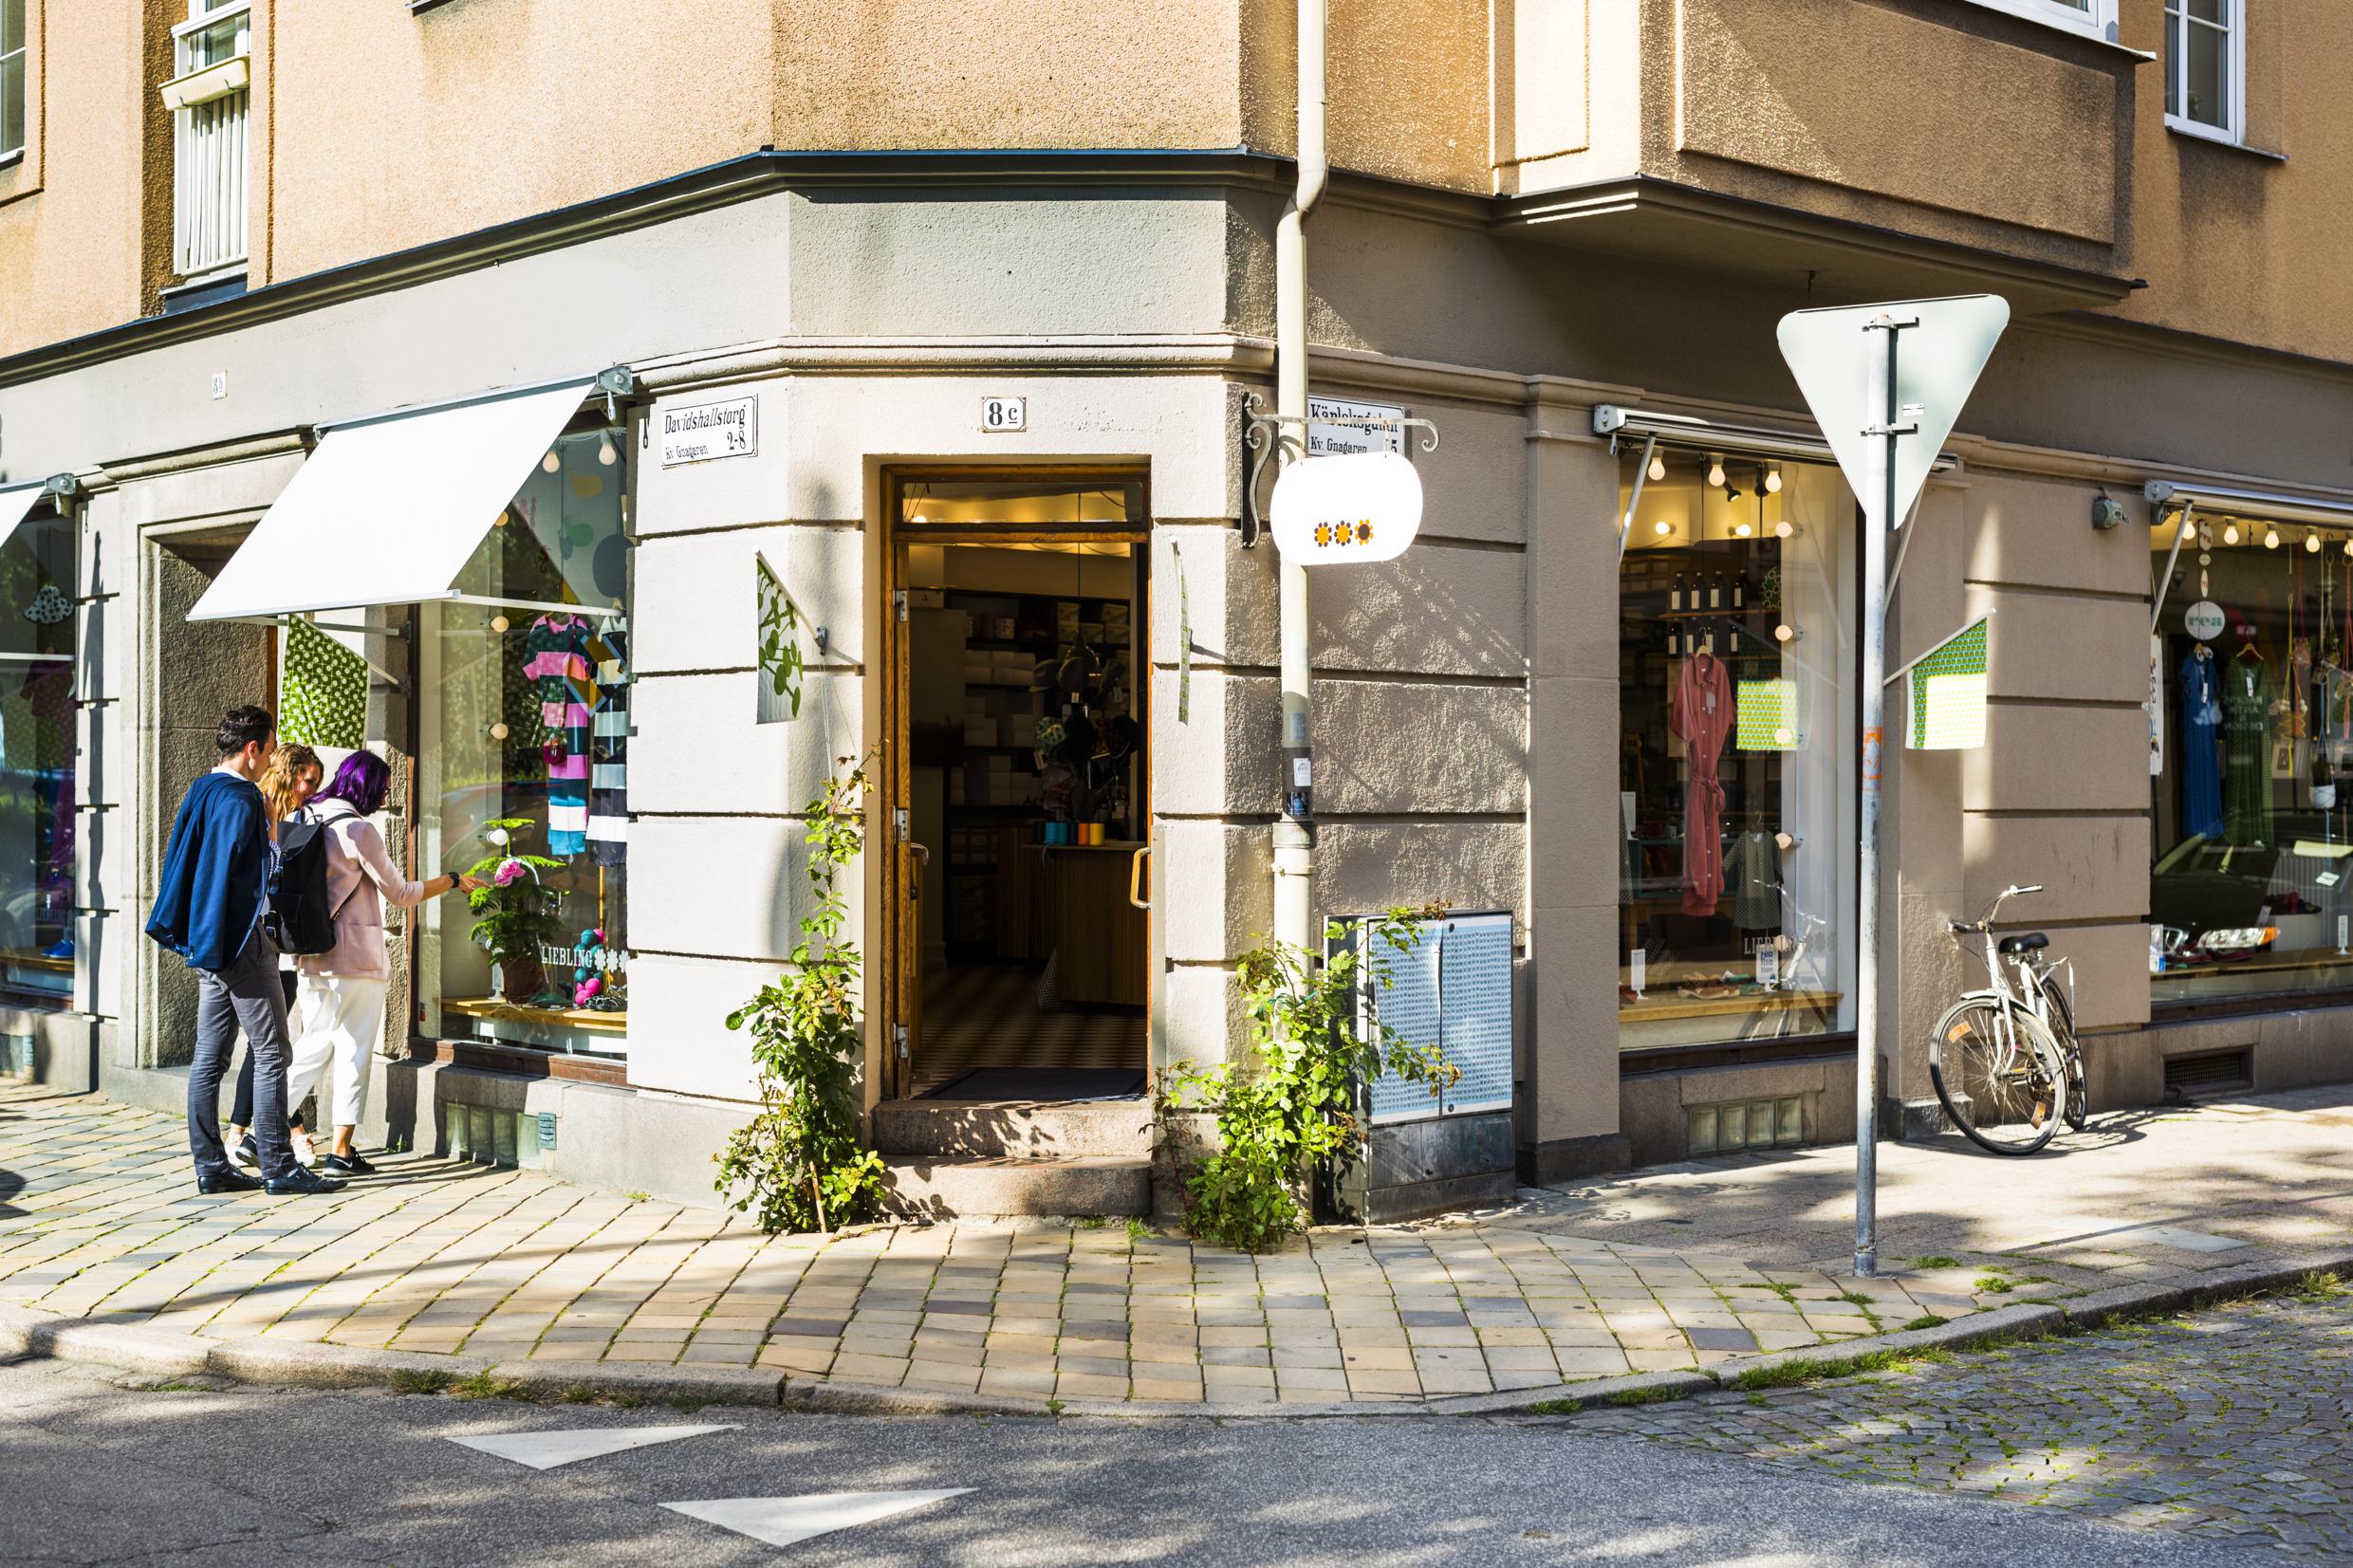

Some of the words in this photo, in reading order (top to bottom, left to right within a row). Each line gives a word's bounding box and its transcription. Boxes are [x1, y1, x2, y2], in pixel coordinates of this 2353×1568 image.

[664, 404, 747, 434] Davidshallstorg
[676, 444, 709, 459] Gnagaren
[727, 430, 747, 451] 2-8
[1310, 435, 1325, 452] Kv.
[1326, 437, 1367, 454] Gnagaren
[2188, 616, 2222, 627] rea
[541, 946, 593, 968] LIEBLING
